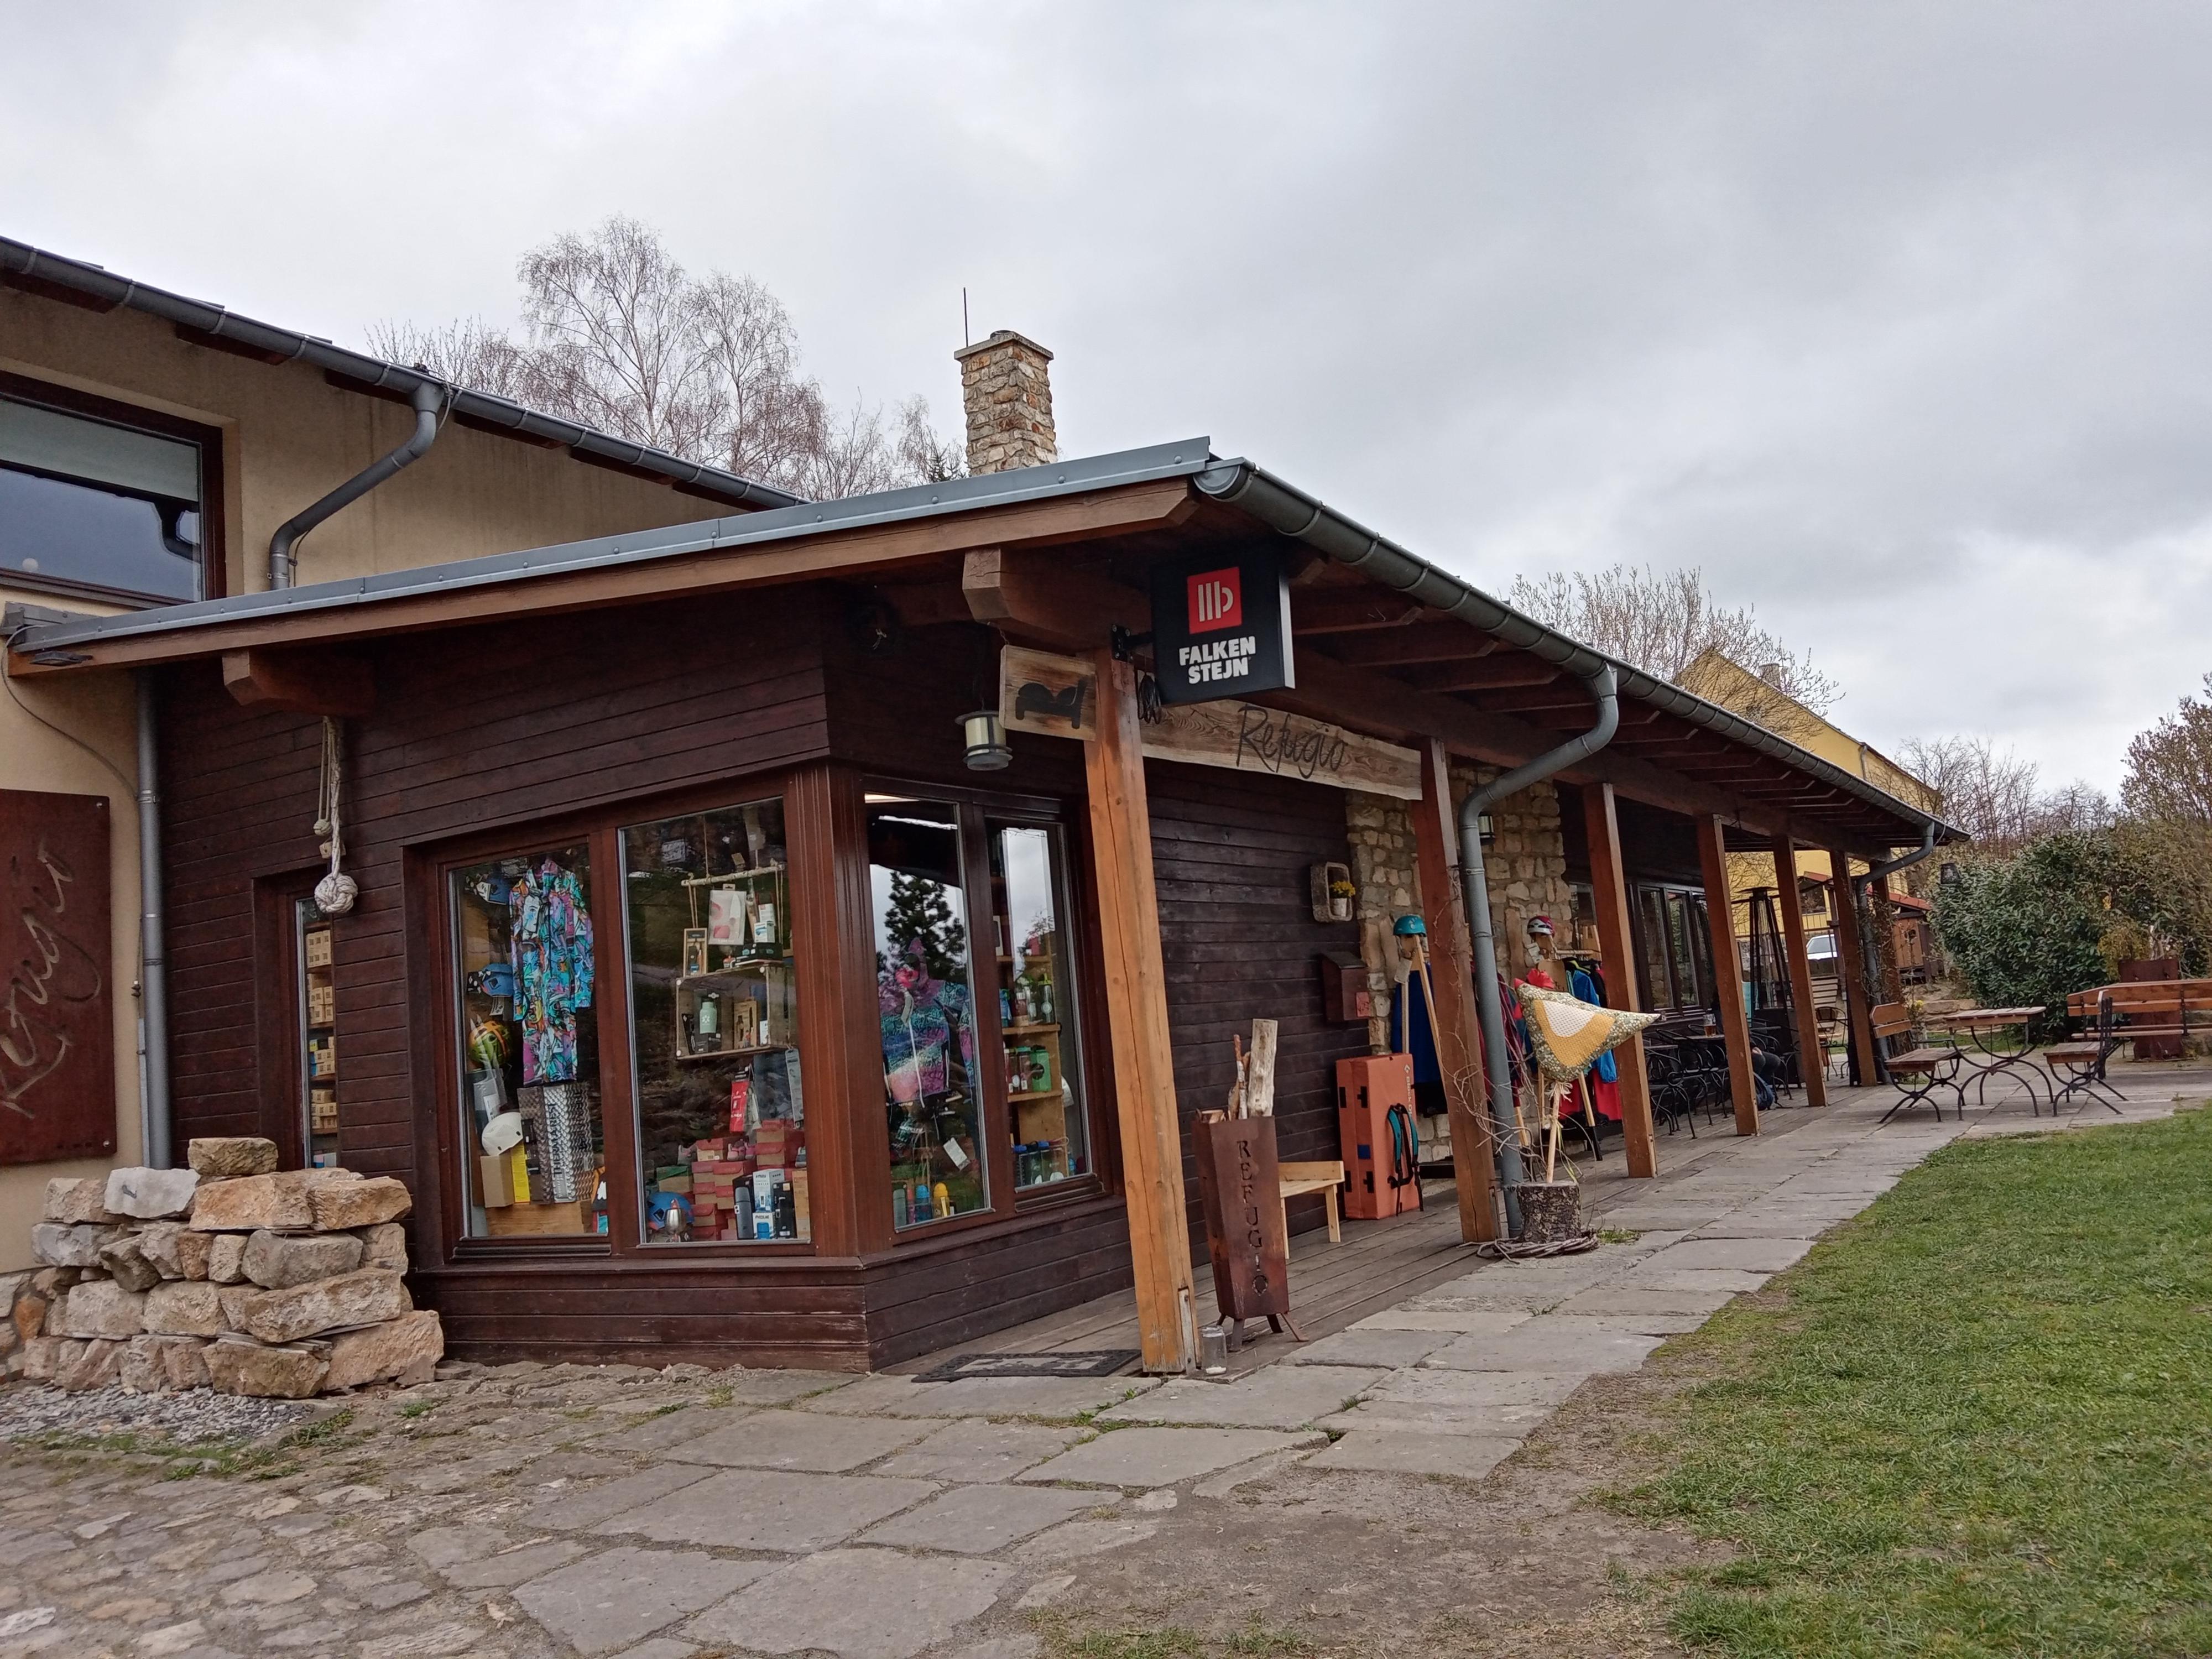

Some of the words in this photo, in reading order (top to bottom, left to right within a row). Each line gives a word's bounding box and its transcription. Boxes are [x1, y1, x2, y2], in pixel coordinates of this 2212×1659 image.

[1179, 635, 1256, 666] FALKEN
[1188, 656, 1249, 684] STEJN
[1236, 703, 1348, 779] Refugio
[1237, 1140, 1269, 1297] REFUGIO
